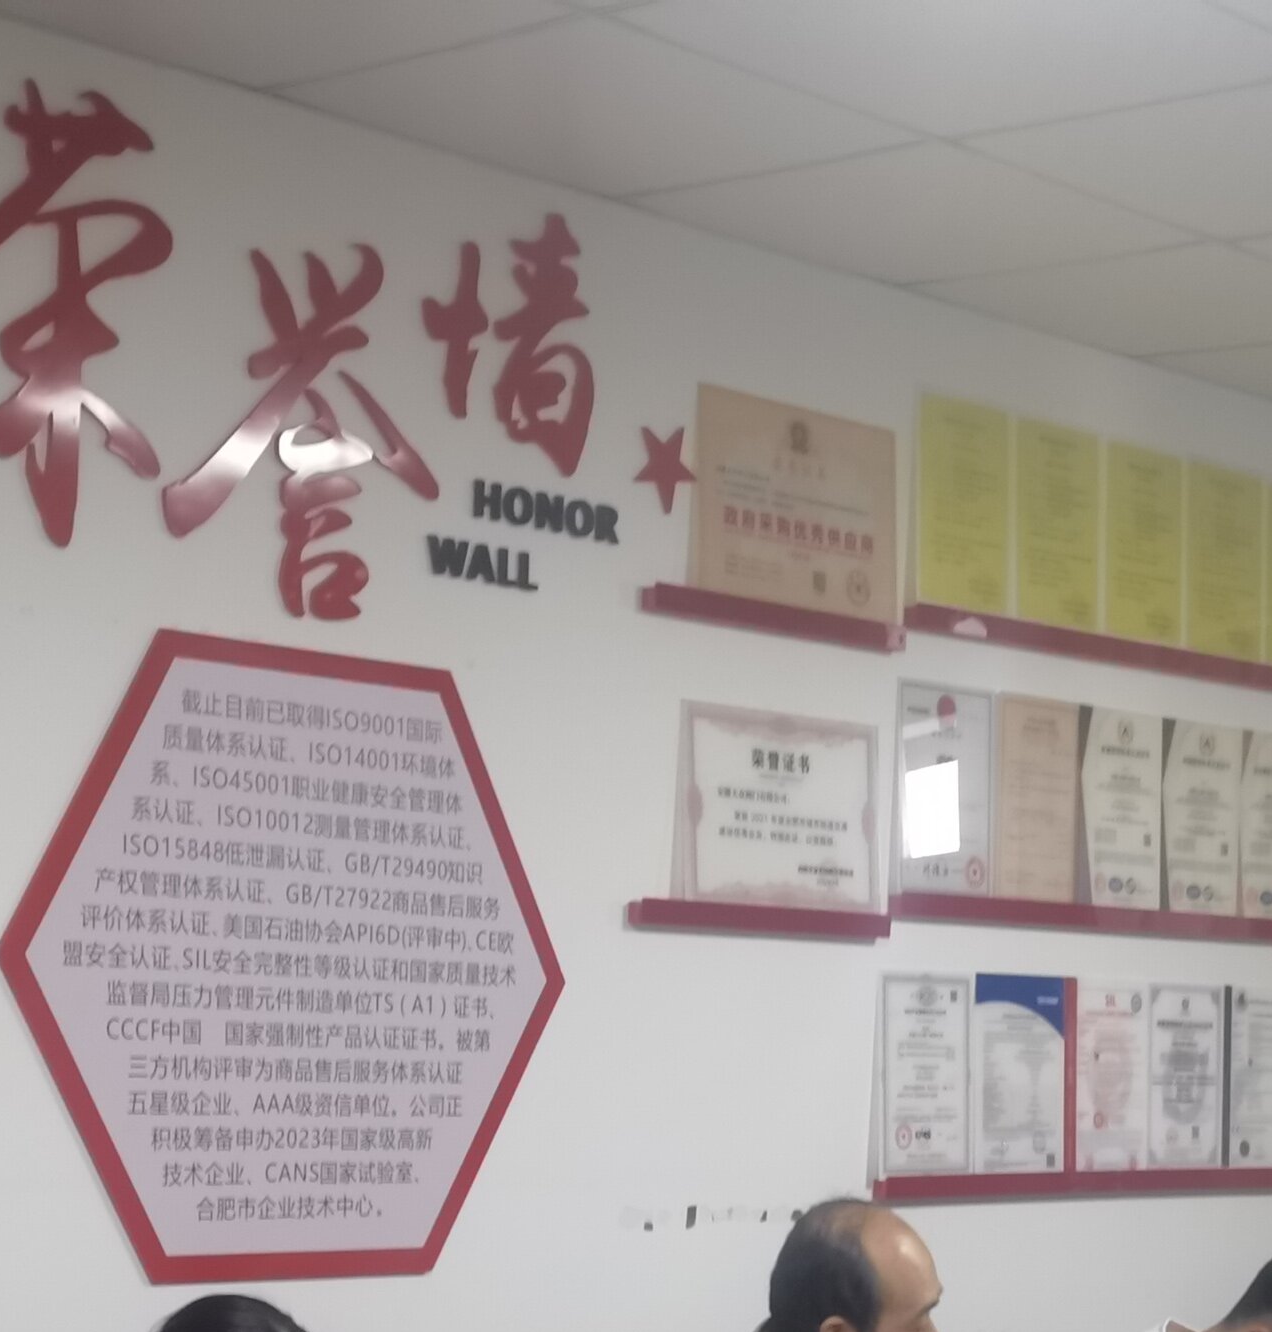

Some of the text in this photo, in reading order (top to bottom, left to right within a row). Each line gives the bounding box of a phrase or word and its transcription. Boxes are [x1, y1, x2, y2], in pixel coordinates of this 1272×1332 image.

[471, 480, 620, 545] HONOR
[426, 535, 538, 592] WALL
[182, 689, 442, 744] 截止目前已取得ISO9001国际
[163, 723, 455, 779] 质量体系认证、ISO14001环境体
[150, 759, 462, 815] 系、ISO45001职业健康安全管理体
[131, 797, 472, 851] 系认证、ISO10012测量管理体系认证、
[123, 834, 483, 885] ISO15848低泄漏认证、GB/T29490知识
[95, 868, 500, 920] 产权管理体系认证、GB/T27922商品售后服务
[62, 941, 516, 987] 盟安全认证、SIL安全完整性等级认证和国家质量技术
[106, 1017, 491, 1053] CCCF中国 国家强制性产品认证证书。被第
[128, 1054, 462, 1085] 三方机构评审为商品售后服务体系认证
[128, 1090, 462, 1118] 五星级企业、AAA级资信单位。公司正
[151, 1127, 432, 1152] 积极筹备申办2023年国家级高新
[163, 1162, 419, 1188] 技术企业、CANS国家试验室、
[196, 1195, 382, 1222] 合肥市企业技术中心。
